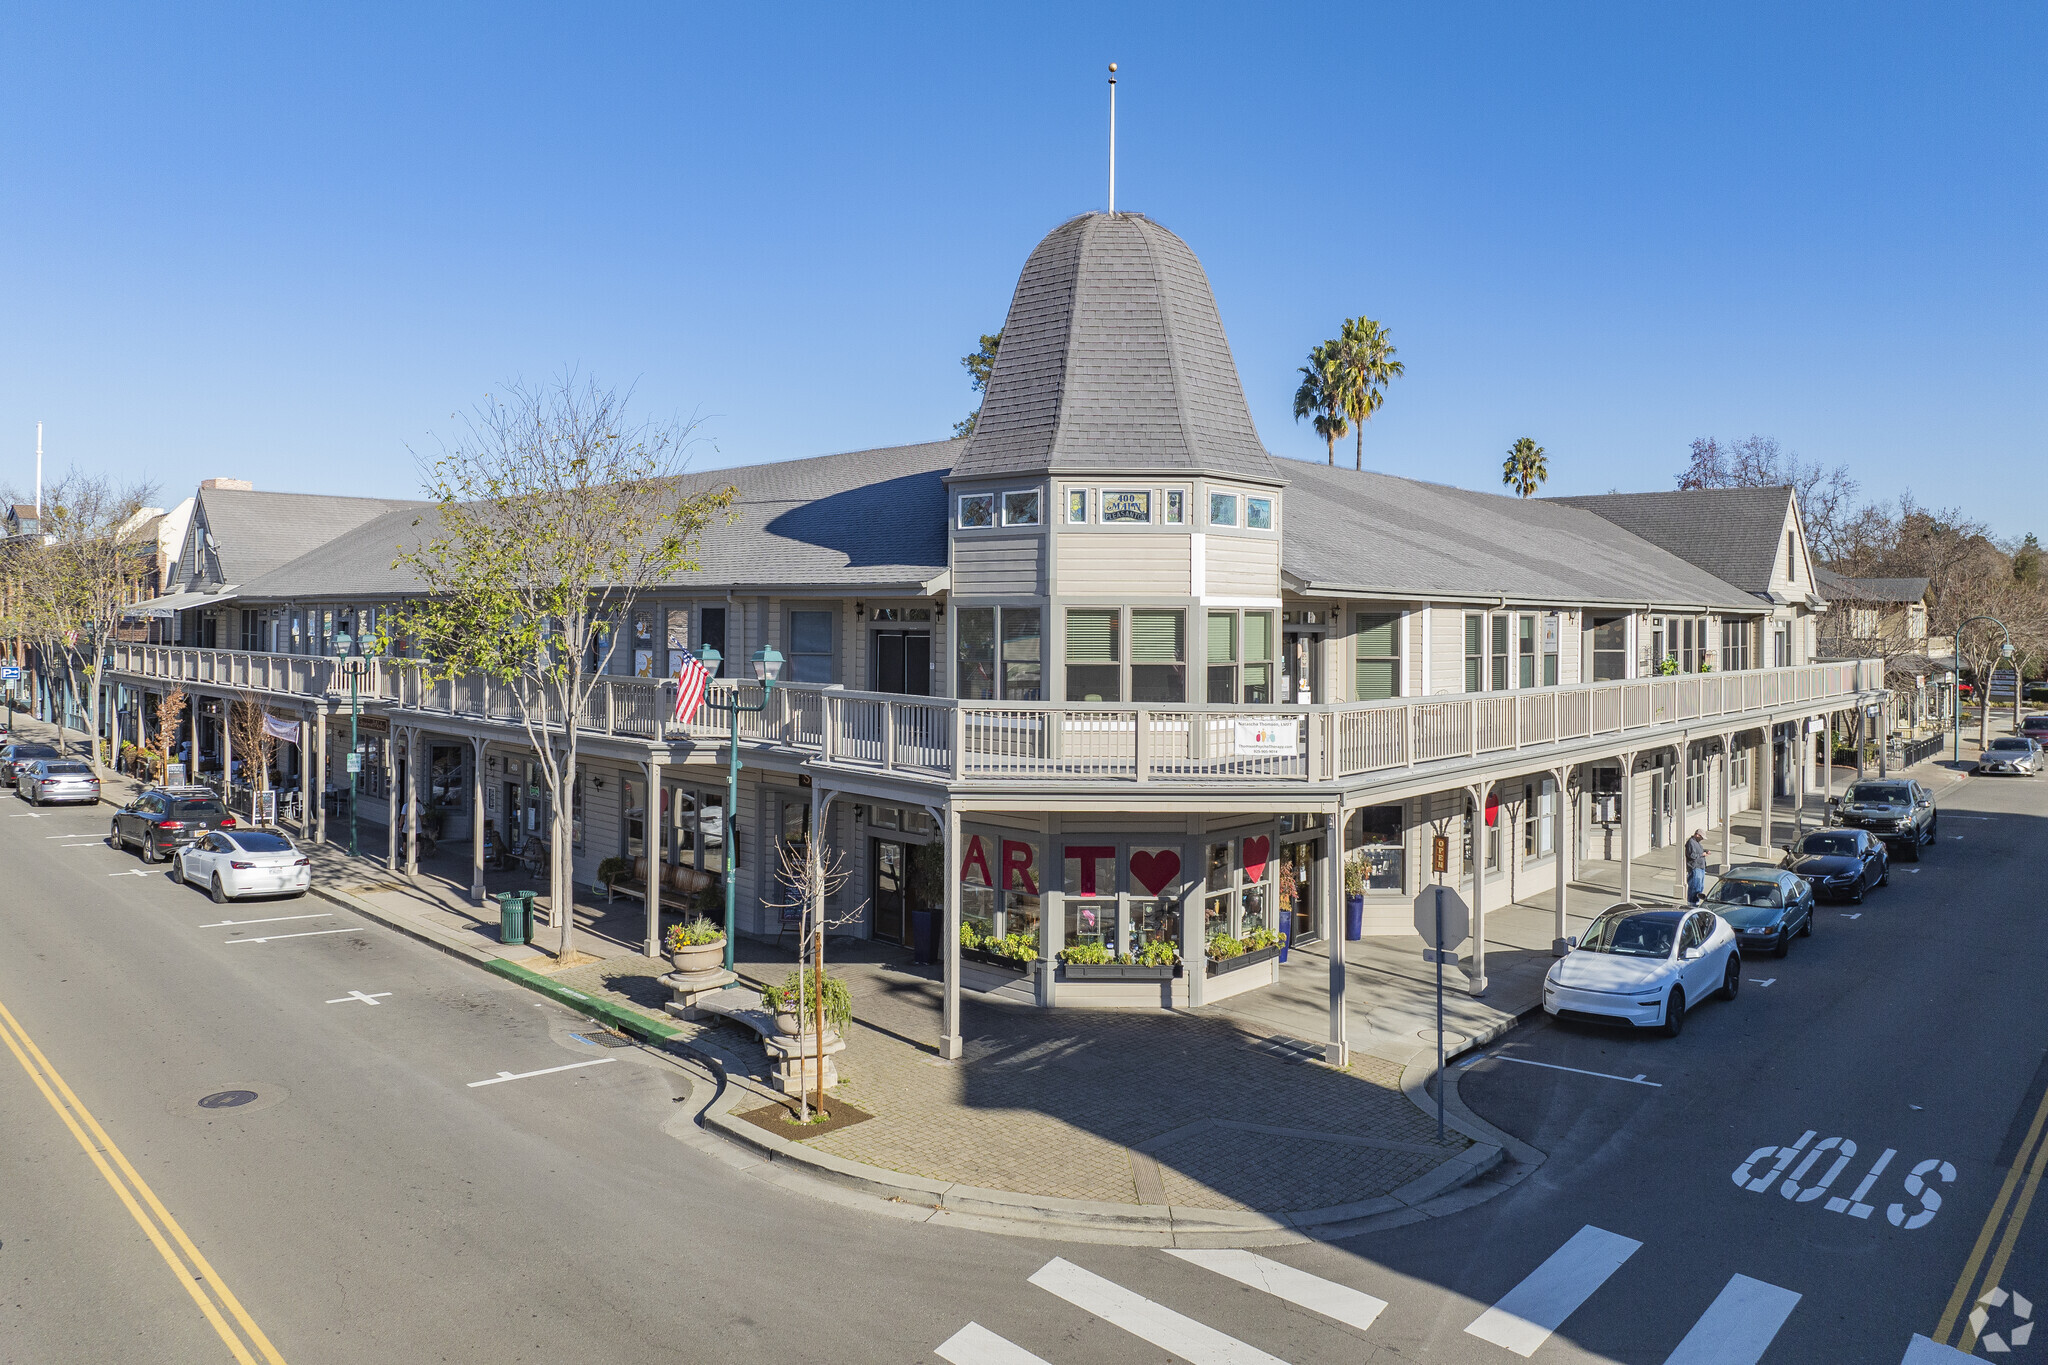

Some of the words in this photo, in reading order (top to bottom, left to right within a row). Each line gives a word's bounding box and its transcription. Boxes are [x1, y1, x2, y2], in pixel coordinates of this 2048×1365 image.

[1105, 510, 1146, 520] PLEASANTON
[2, 669, 12, 678] P
[961, 834, 1115, 897] ART
[1731, 1130, 1957, 1230] STOP
